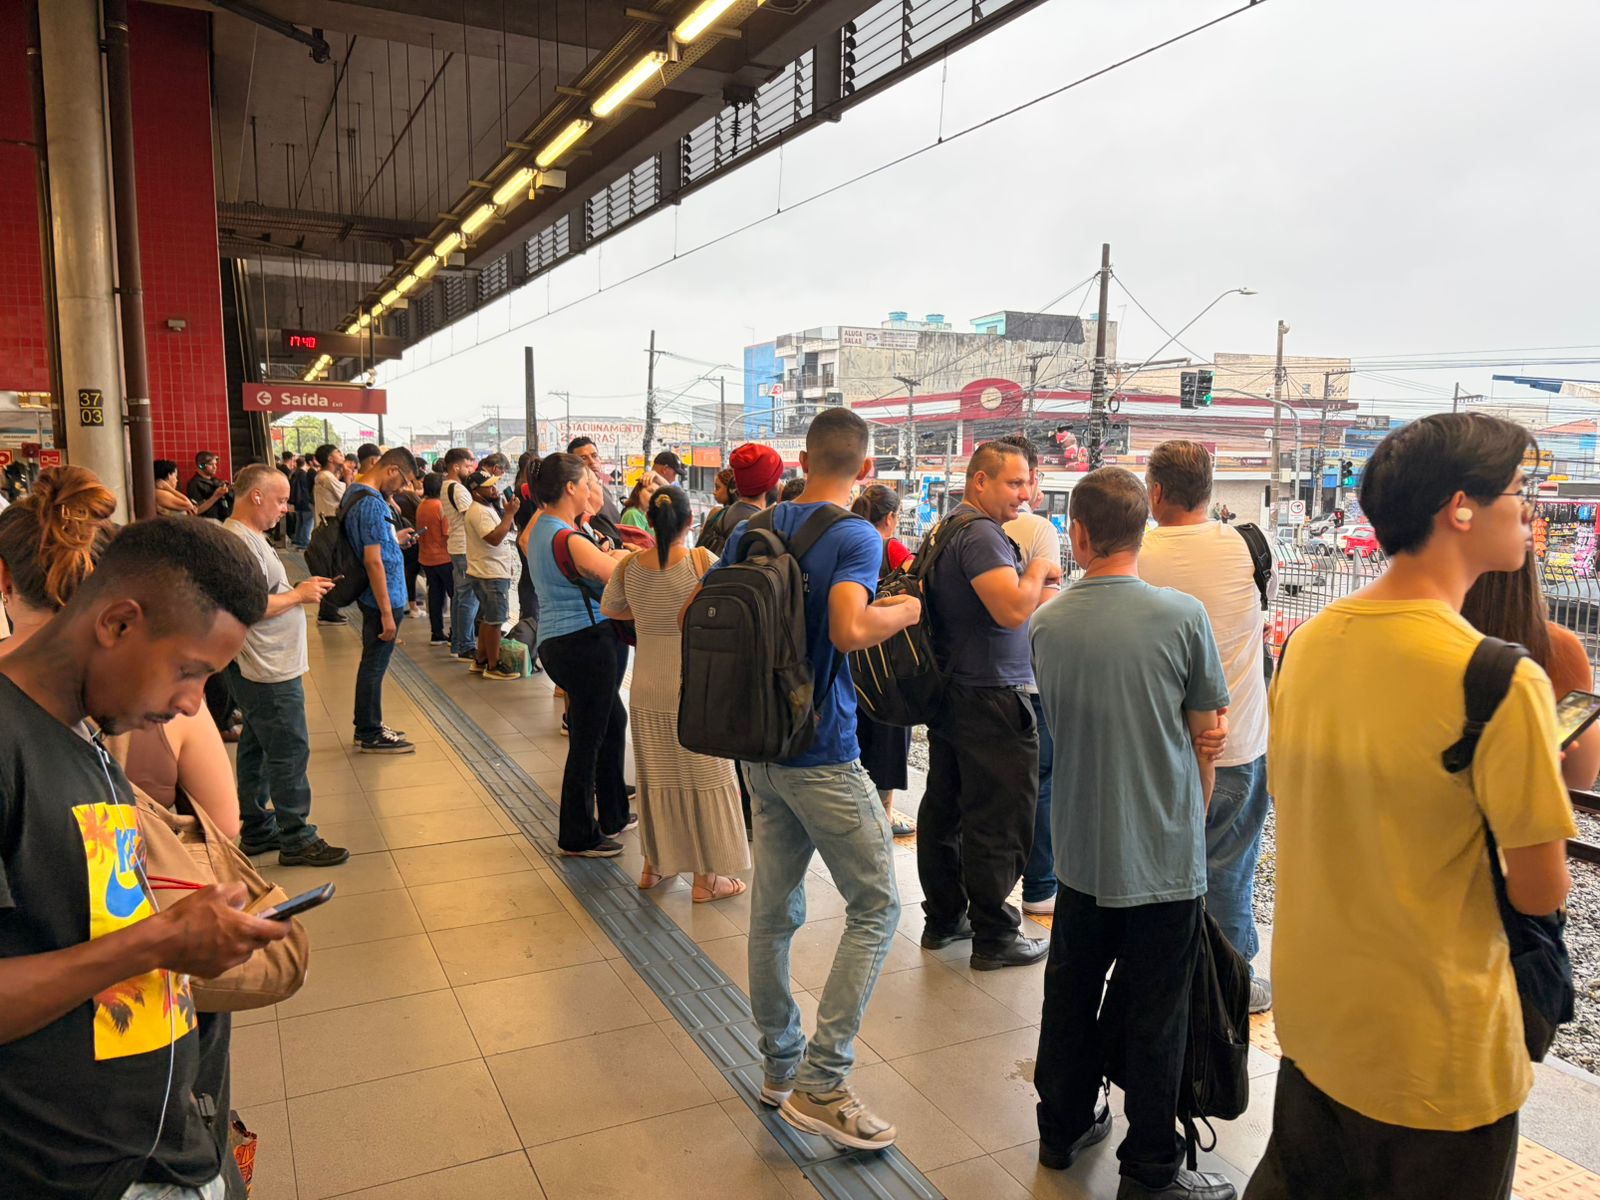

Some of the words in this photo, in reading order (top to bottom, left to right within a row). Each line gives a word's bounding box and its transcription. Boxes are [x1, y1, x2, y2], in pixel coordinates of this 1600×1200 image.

[80, 392, 100, 406] 37
[281, 392, 328, 407] Saída
[82, 409, 103, 423] 03
[560, 423, 643, 433] ESTACIONAMENTO
